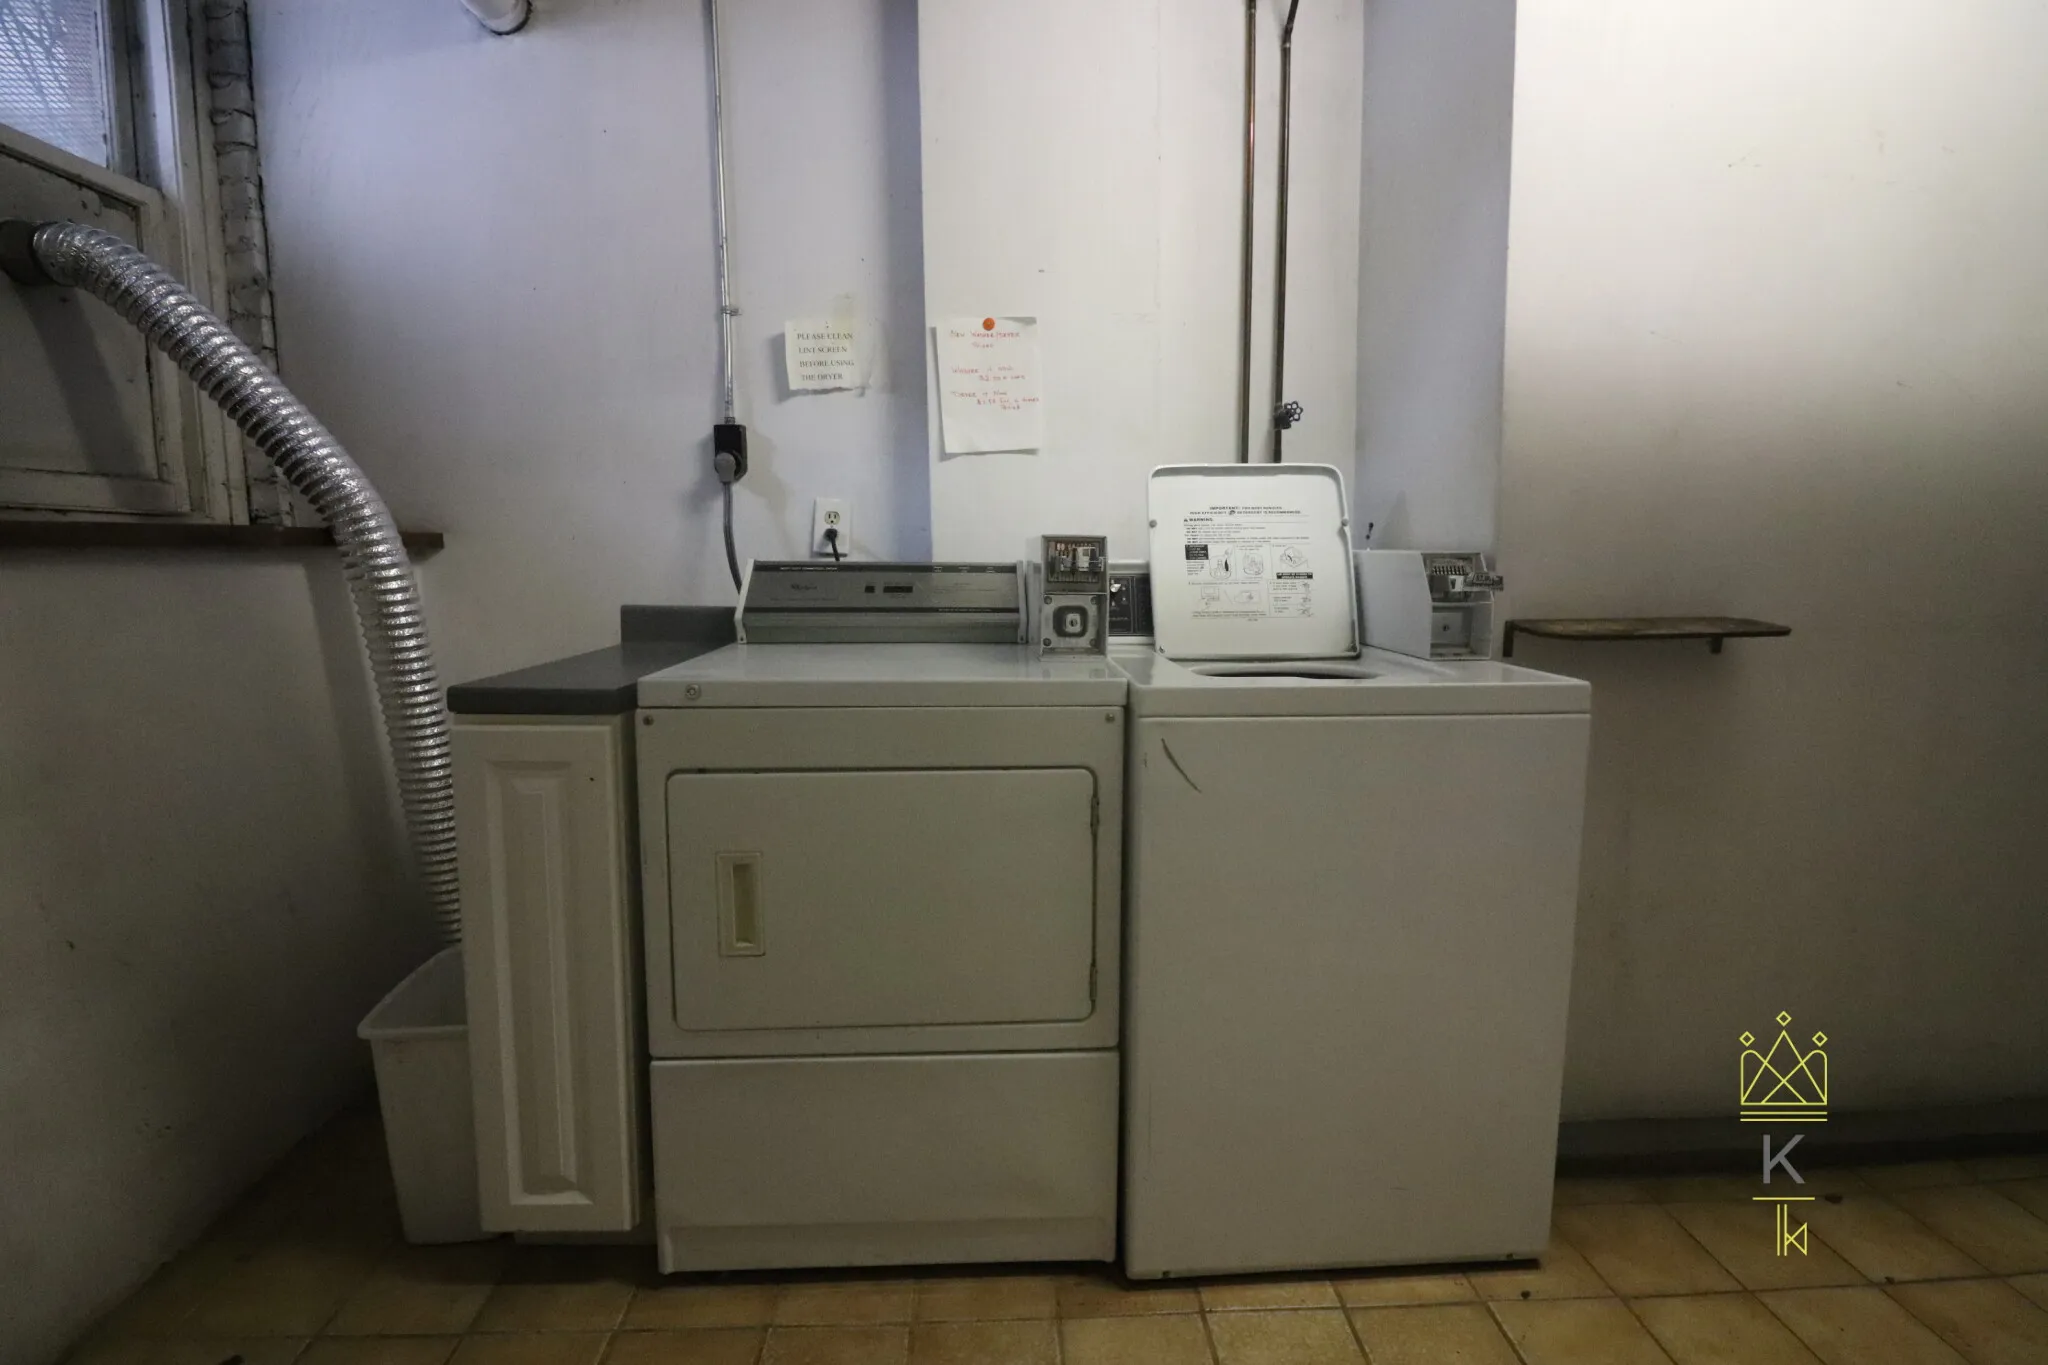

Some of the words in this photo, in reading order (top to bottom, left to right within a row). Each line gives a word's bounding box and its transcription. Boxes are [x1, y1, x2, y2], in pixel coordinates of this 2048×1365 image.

[797, 332, 825, 340] PLEASE
[827, 332, 853, 340] CLEAN
[799, 360, 828, 368] BEFORE
[830, 359, 854, 367] USING
[817, 373, 843, 381] DRYER
